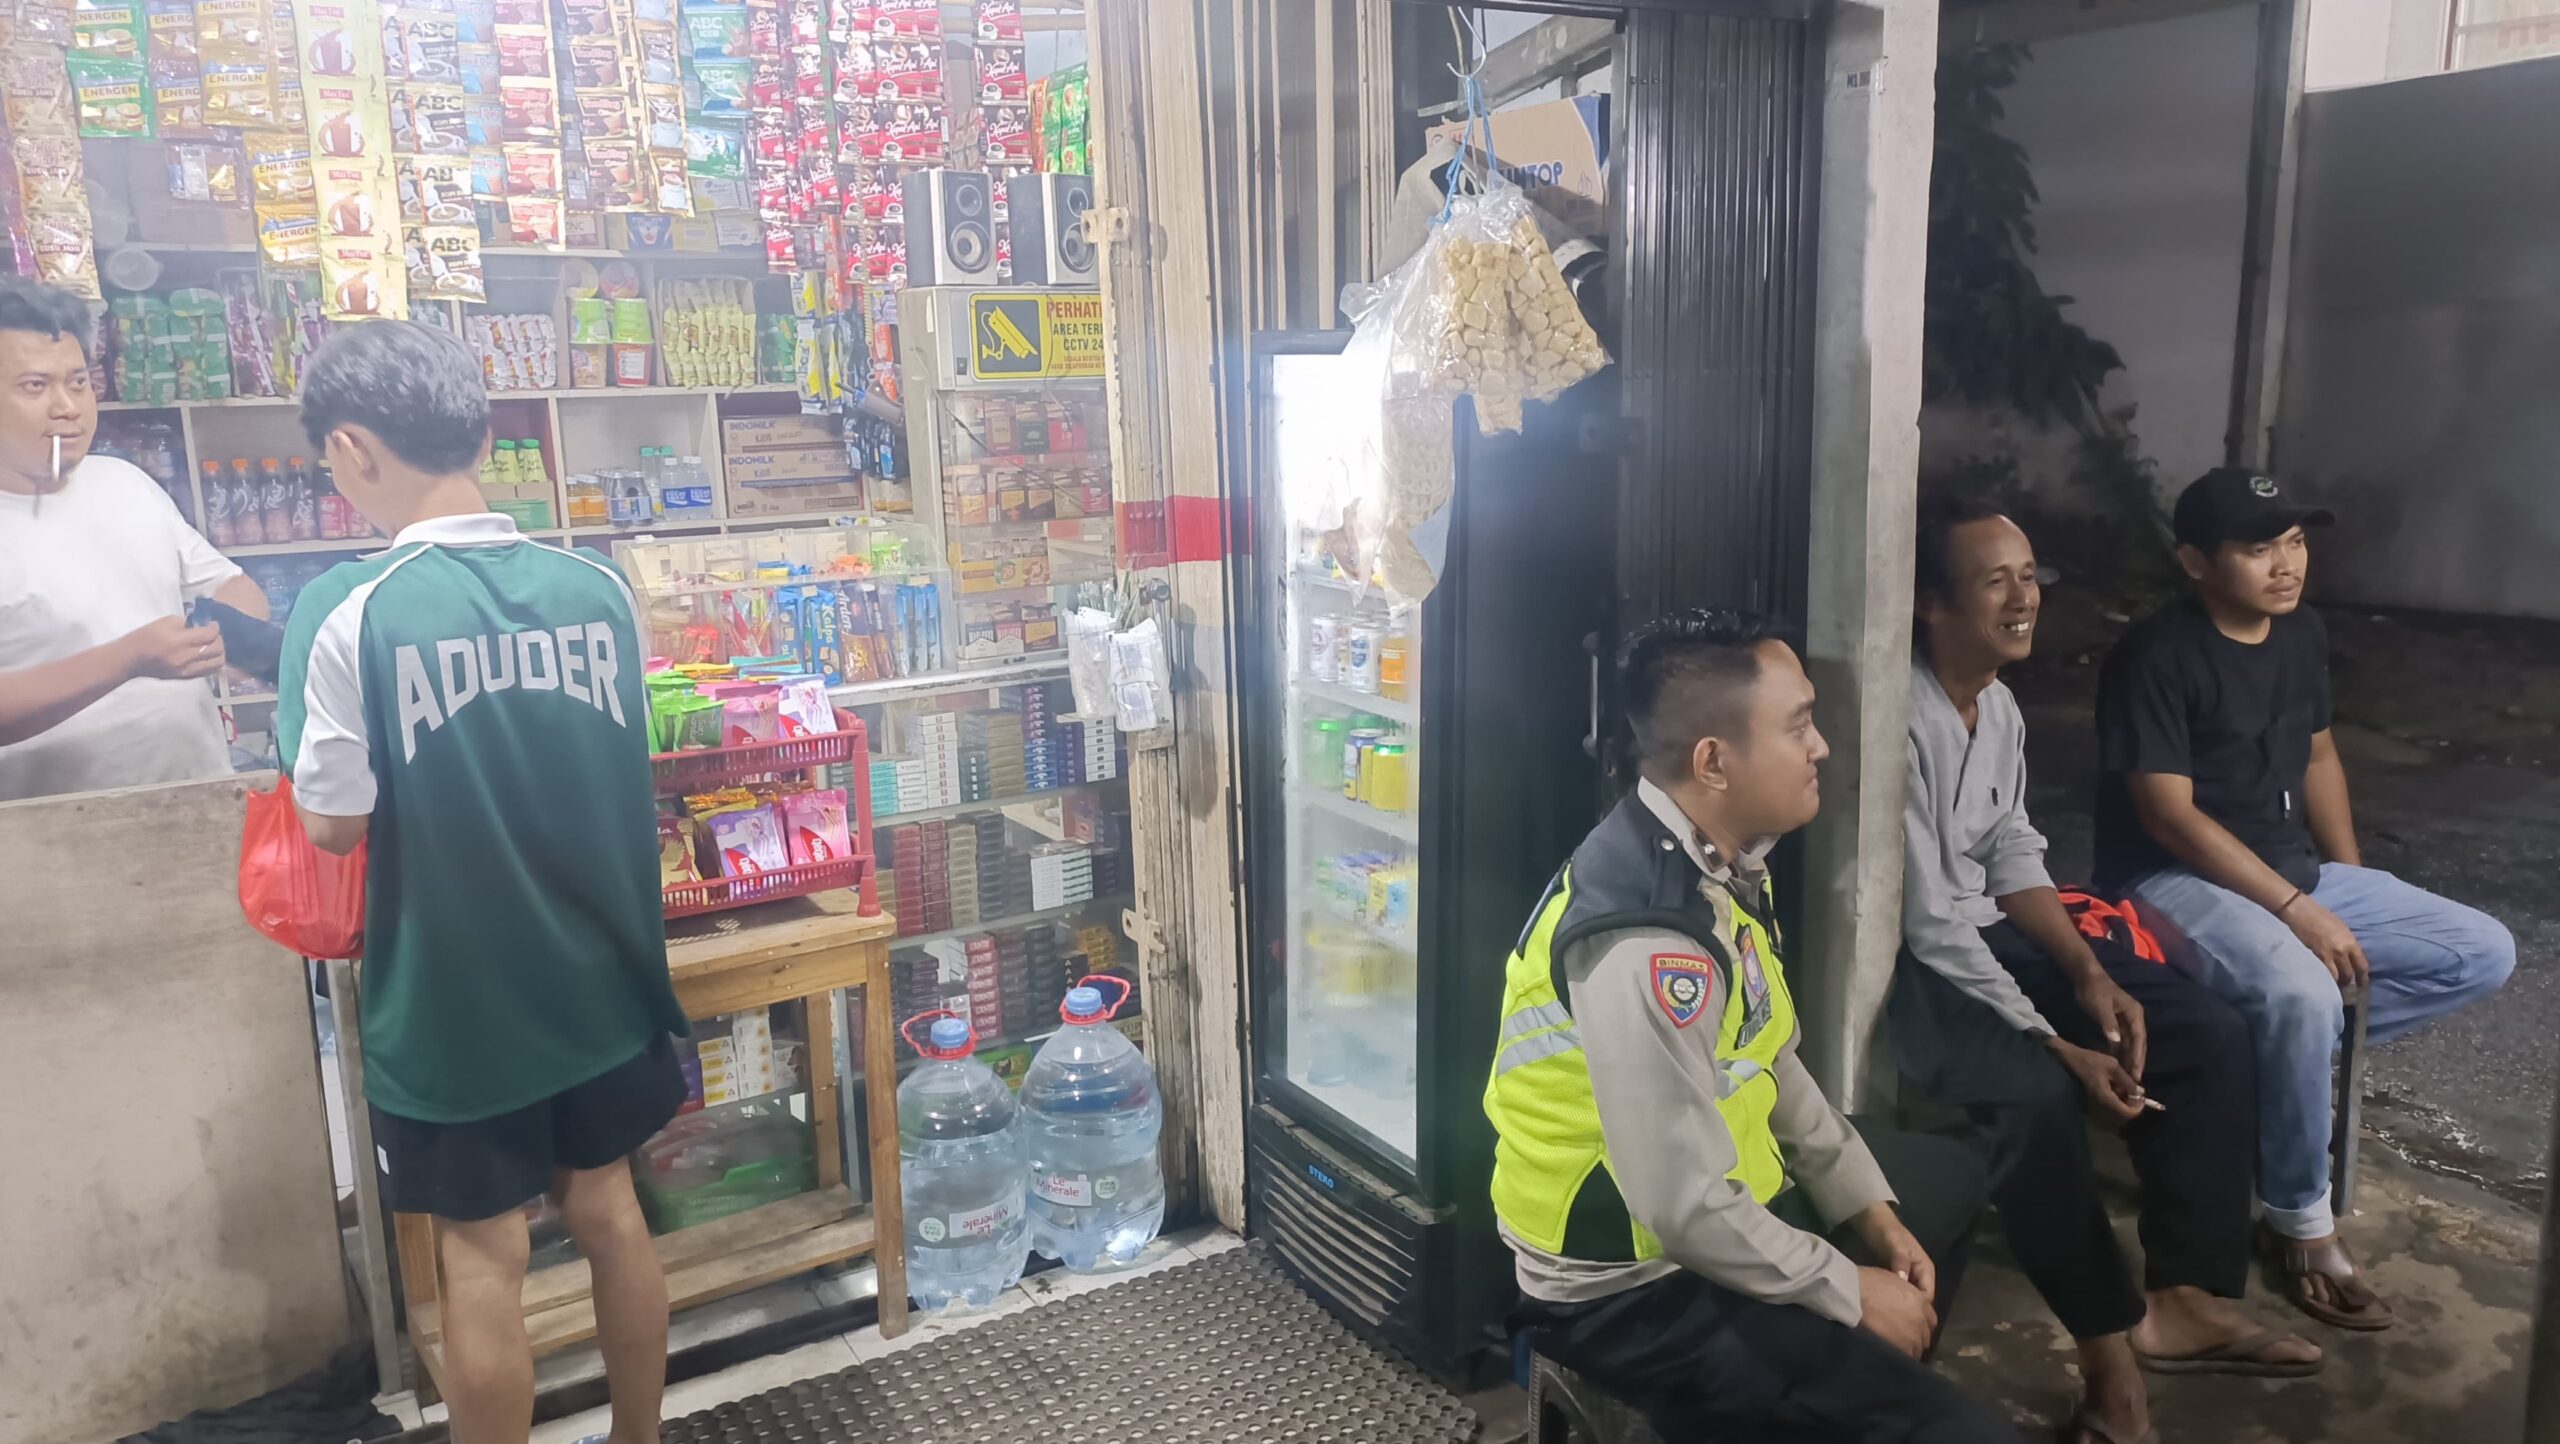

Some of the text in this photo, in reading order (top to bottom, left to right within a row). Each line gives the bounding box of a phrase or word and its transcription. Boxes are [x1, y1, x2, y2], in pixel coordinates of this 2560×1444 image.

[203, 1, 256, 12] ENERGEN
[689, 17, 723, 29] ABC
[985, 61, 1020, 78] Kapal Api
[209, 73, 263, 83] ENERGEN
[83, 86, 137, 97] ENERGEN
[415, 95, 461, 110] ABC
[989, 121, 1024, 138] Kapal Api
[430, 237, 475, 252] ABC
[1053, 323, 1079, 335] AREA
[1064, 339, 1104, 351] CCTV 24
[730, 421, 776, 430] INDOMILK
[728, 456, 775, 465] INDOMILK
[822, 603, 836, 643] Kalpa
[396, 621, 626, 765] ADUDER
[1659, 958, 1706, 972] BINMAS
[1053, 1174, 1065, 1185] Le
[1036, 1177, 1080, 1197] Minerale
[962, 1205, 1009, 1229] Minerale
[977, 1226, 993, 1237] Le
